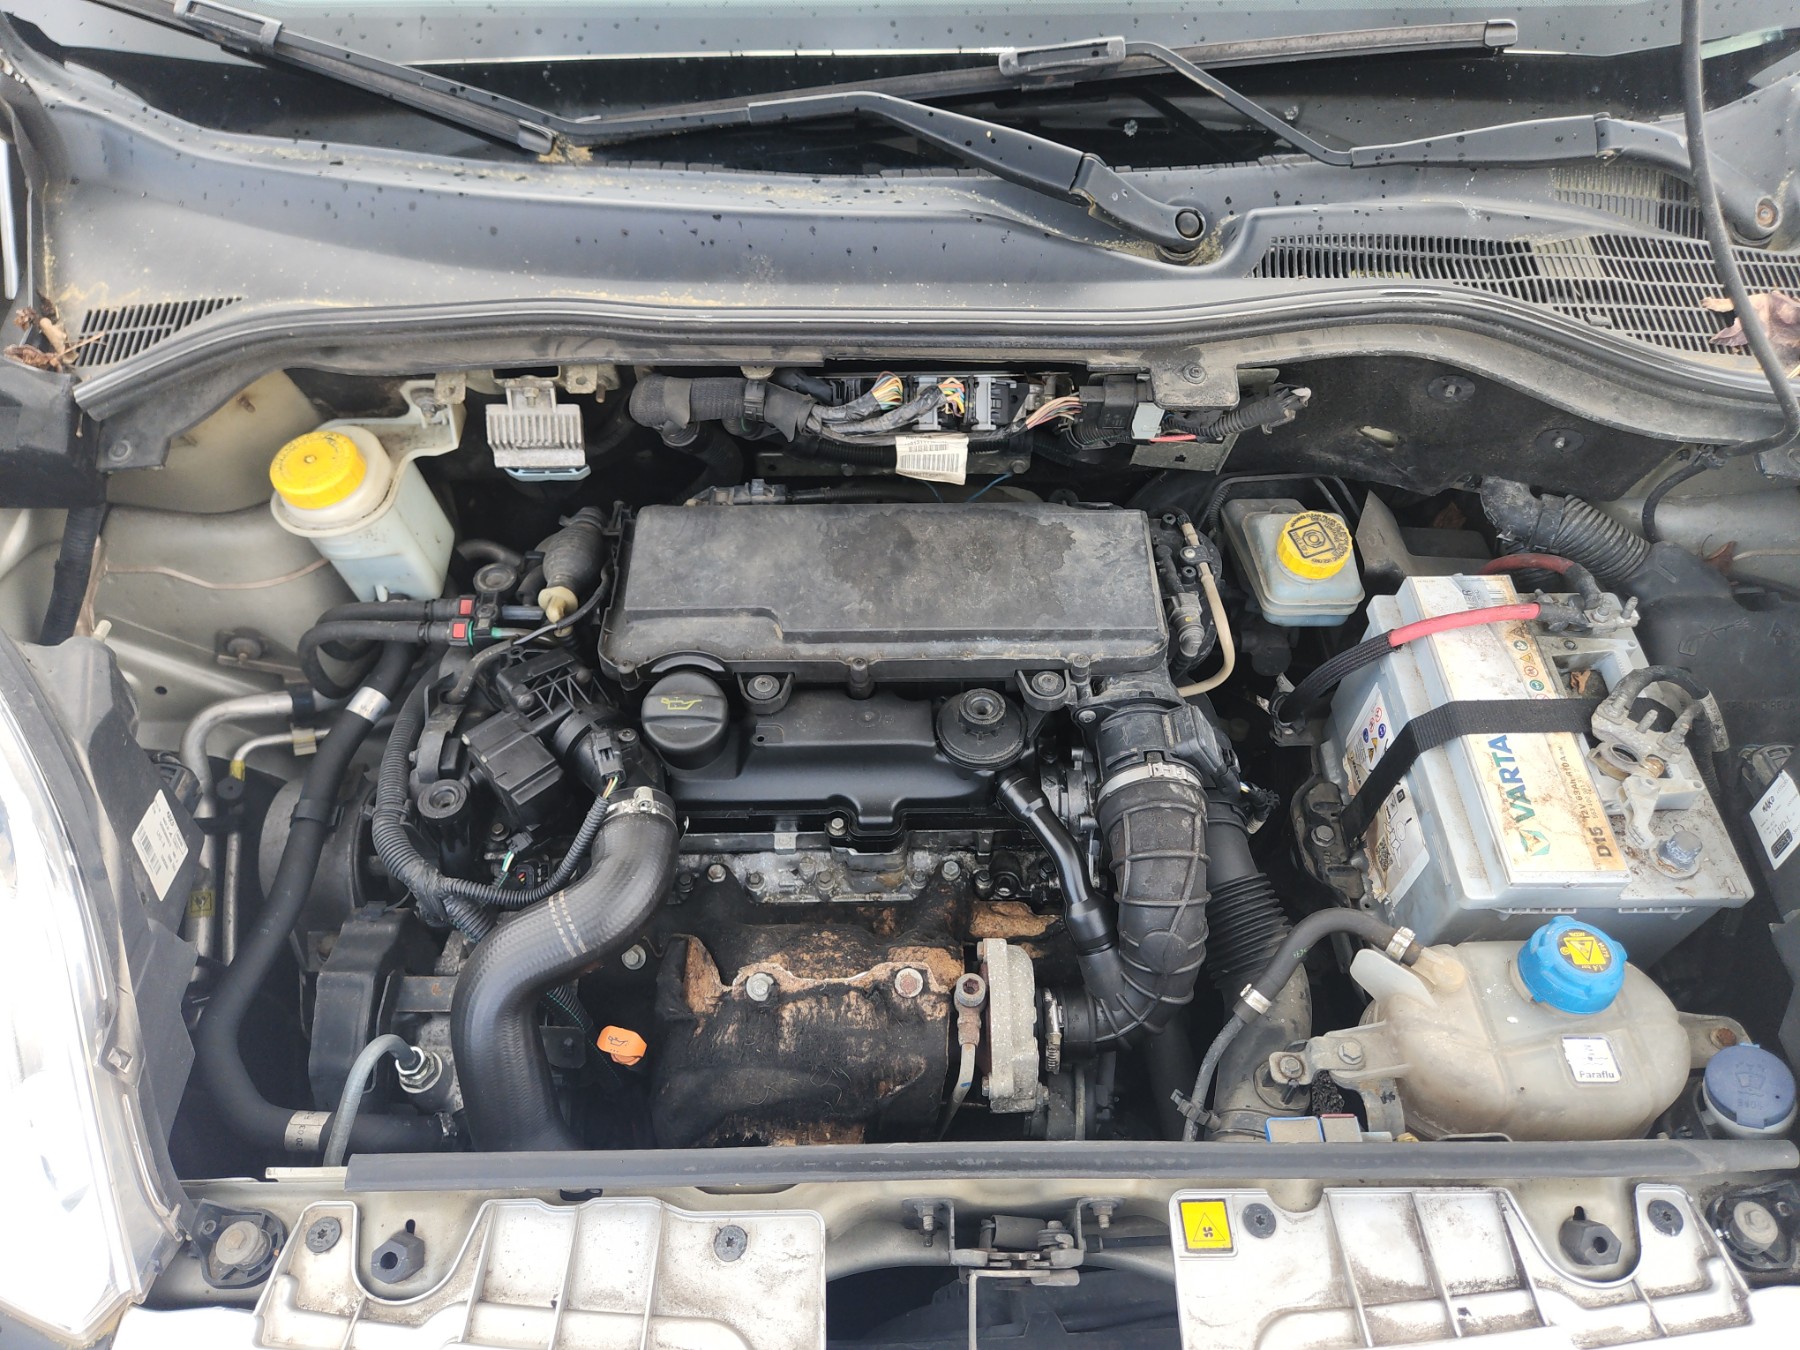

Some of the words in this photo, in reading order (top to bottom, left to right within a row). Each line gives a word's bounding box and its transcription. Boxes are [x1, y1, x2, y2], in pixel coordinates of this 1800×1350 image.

[1488, 734, 1536, 823] VARTA
[1589, 826, 1613, 857] D15
[1579, 1070, 1616, 1079] Paraflu
